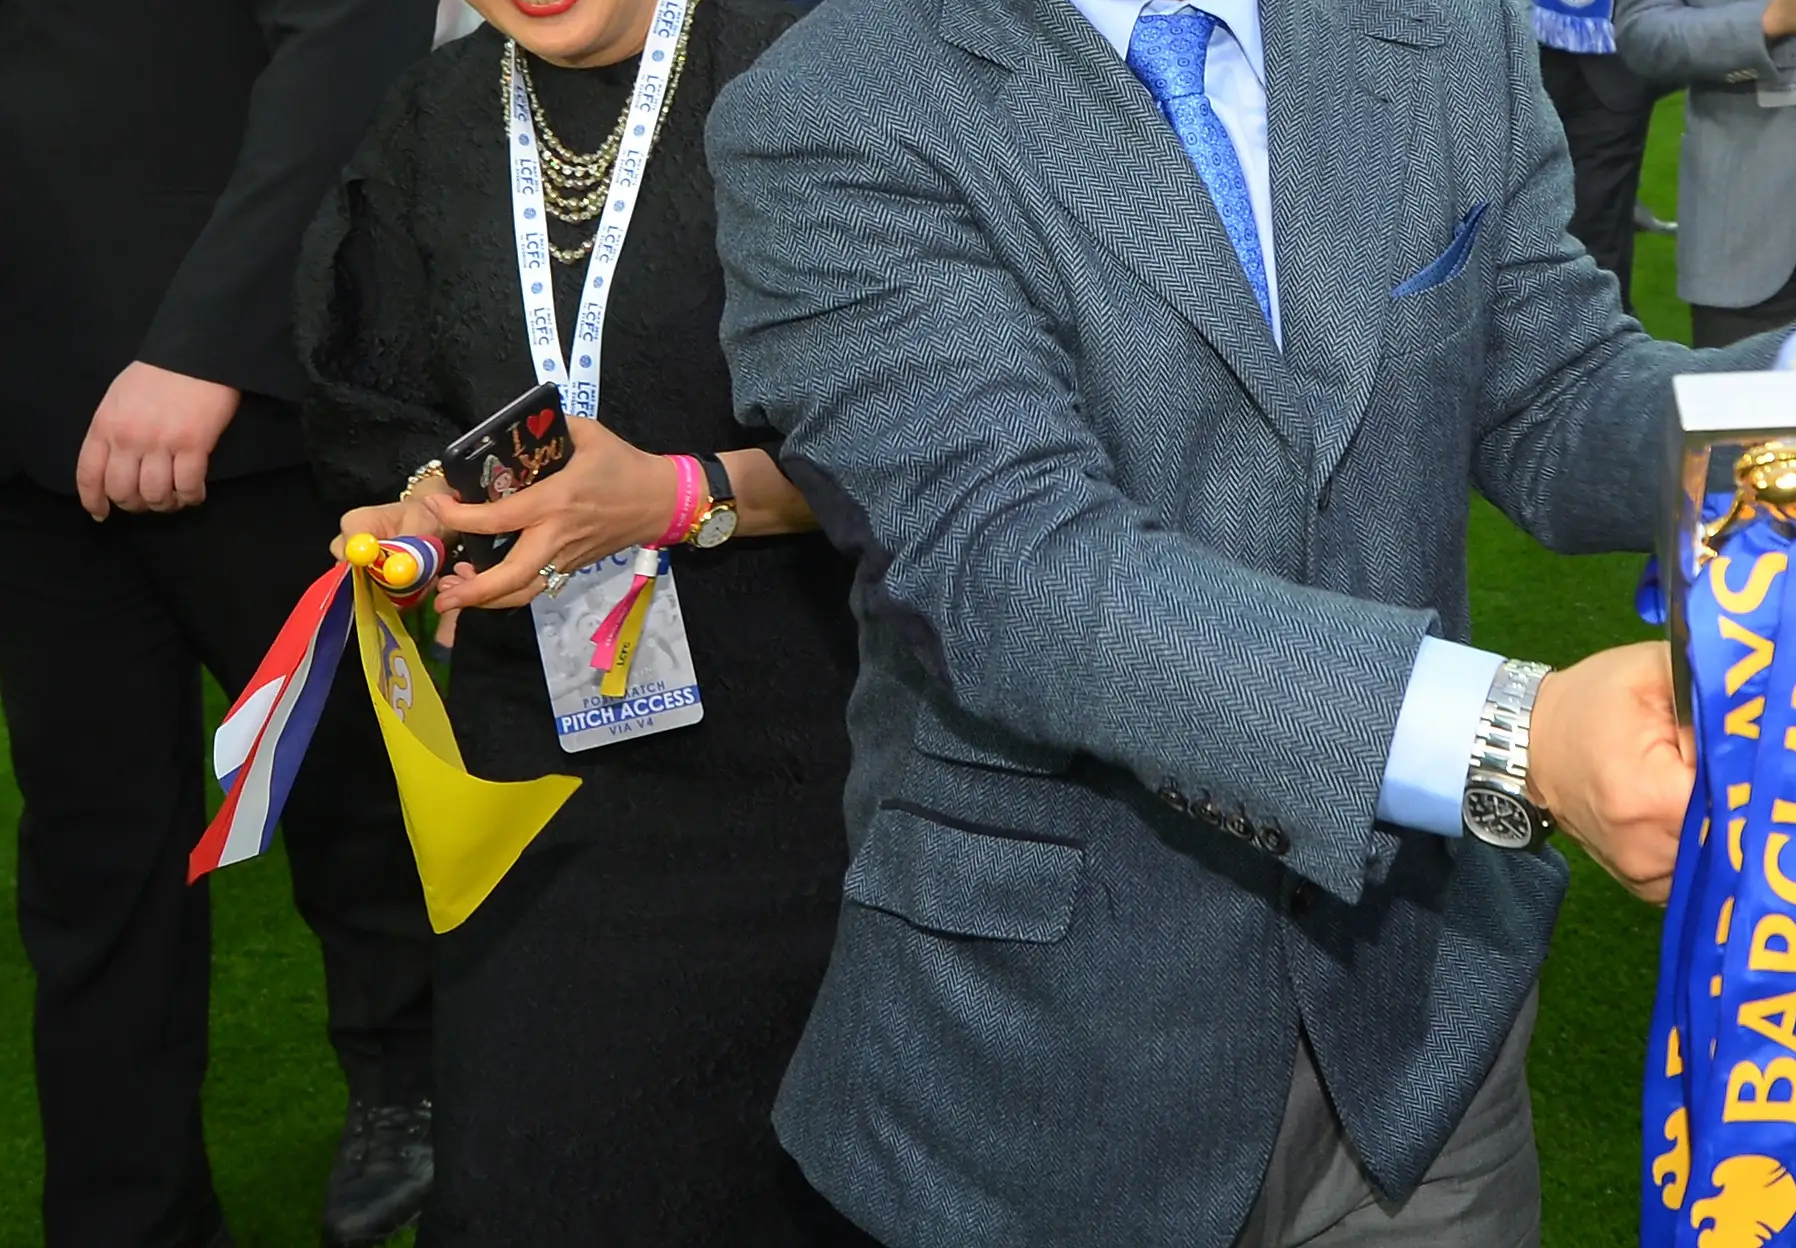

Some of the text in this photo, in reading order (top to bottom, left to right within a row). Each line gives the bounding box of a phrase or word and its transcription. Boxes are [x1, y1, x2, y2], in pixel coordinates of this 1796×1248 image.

[658, 1, 678, 39] LCFC
[640, 74, 659, 113] LCFC
[519, 158, 534, 195] LCFC
[620, 149, 639, 188] LCFC
[525, 232, 541, 269] LCFC
[600, 225, 619, 263] LCFC
[533, 307, 550, 346] LCFC
[583, 302, 598, 342] LCFC
[561, 687, 696, 733] PITCH ACCESS
[608, 717, 655, 736] VIA V4
